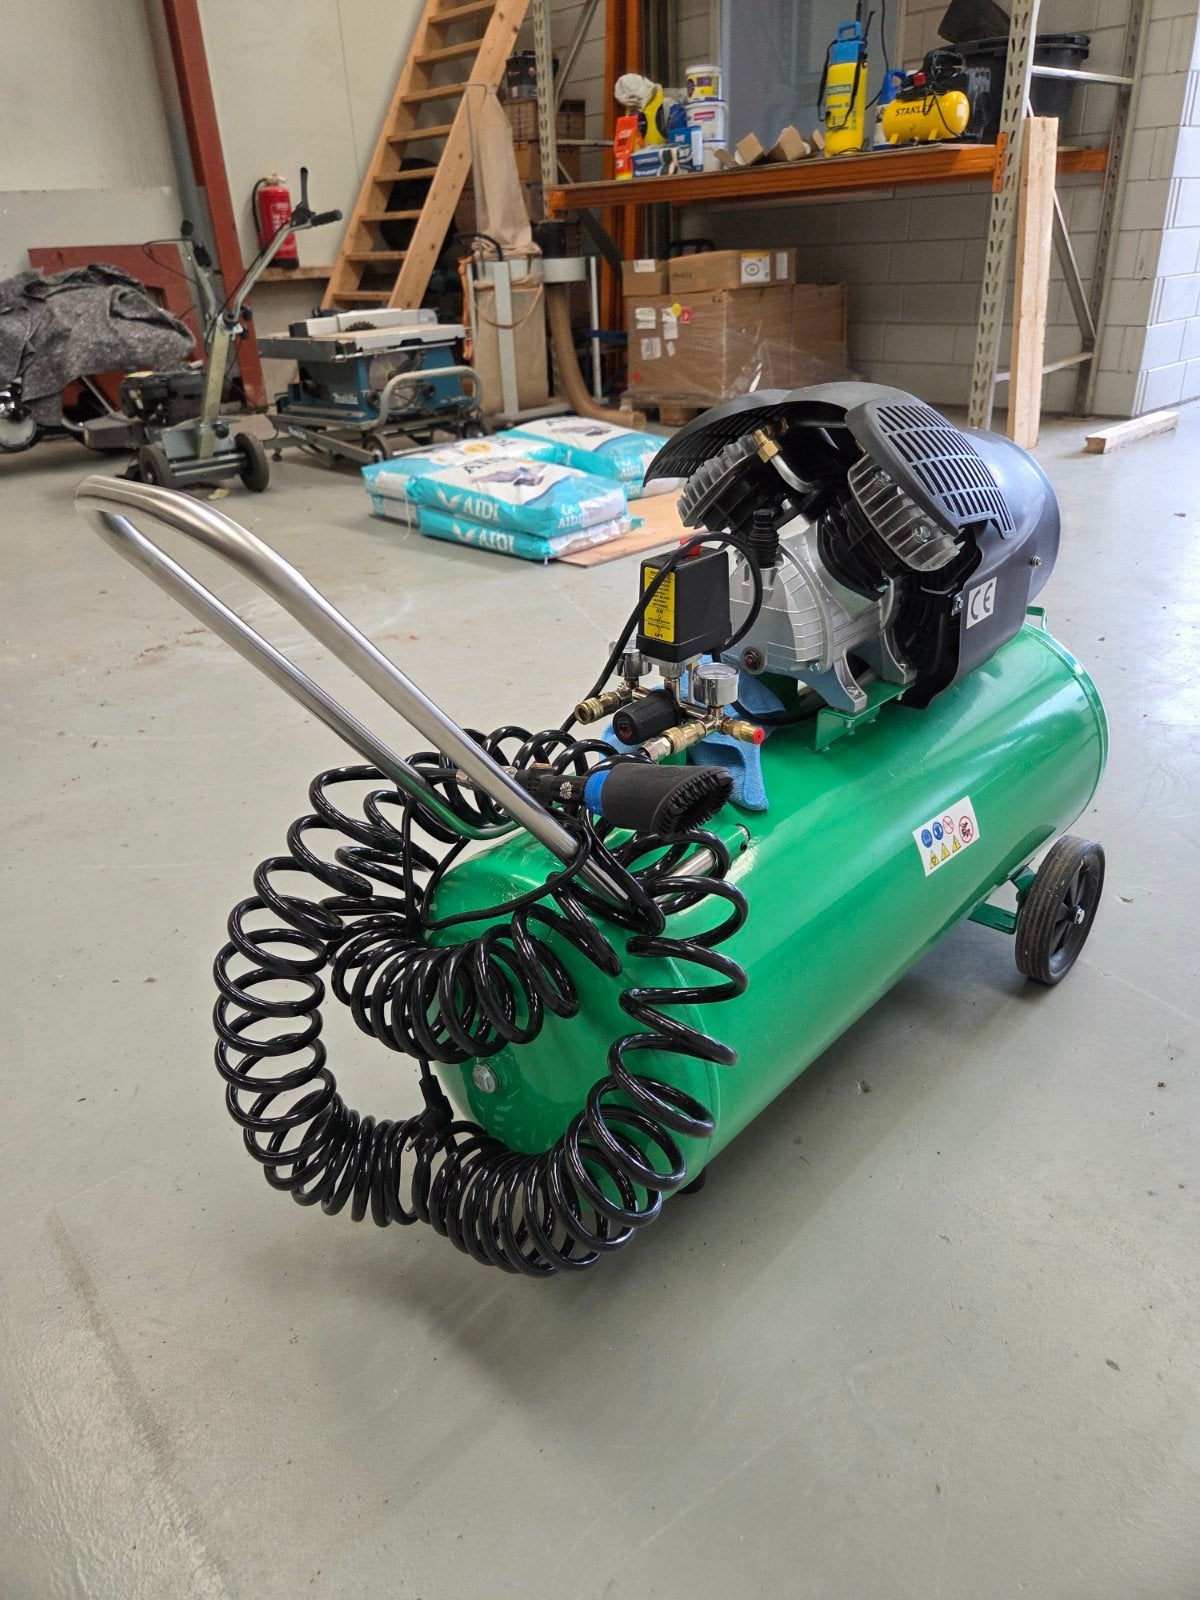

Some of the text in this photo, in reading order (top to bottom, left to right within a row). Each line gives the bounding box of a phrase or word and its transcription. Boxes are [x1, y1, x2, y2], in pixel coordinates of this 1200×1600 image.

[895, 105, 932, 116] STANLE
[462, 496, 501, 522] AIDI
[477, 528, 516, 553] AIDI
[970, 581, 994, 621] CE
